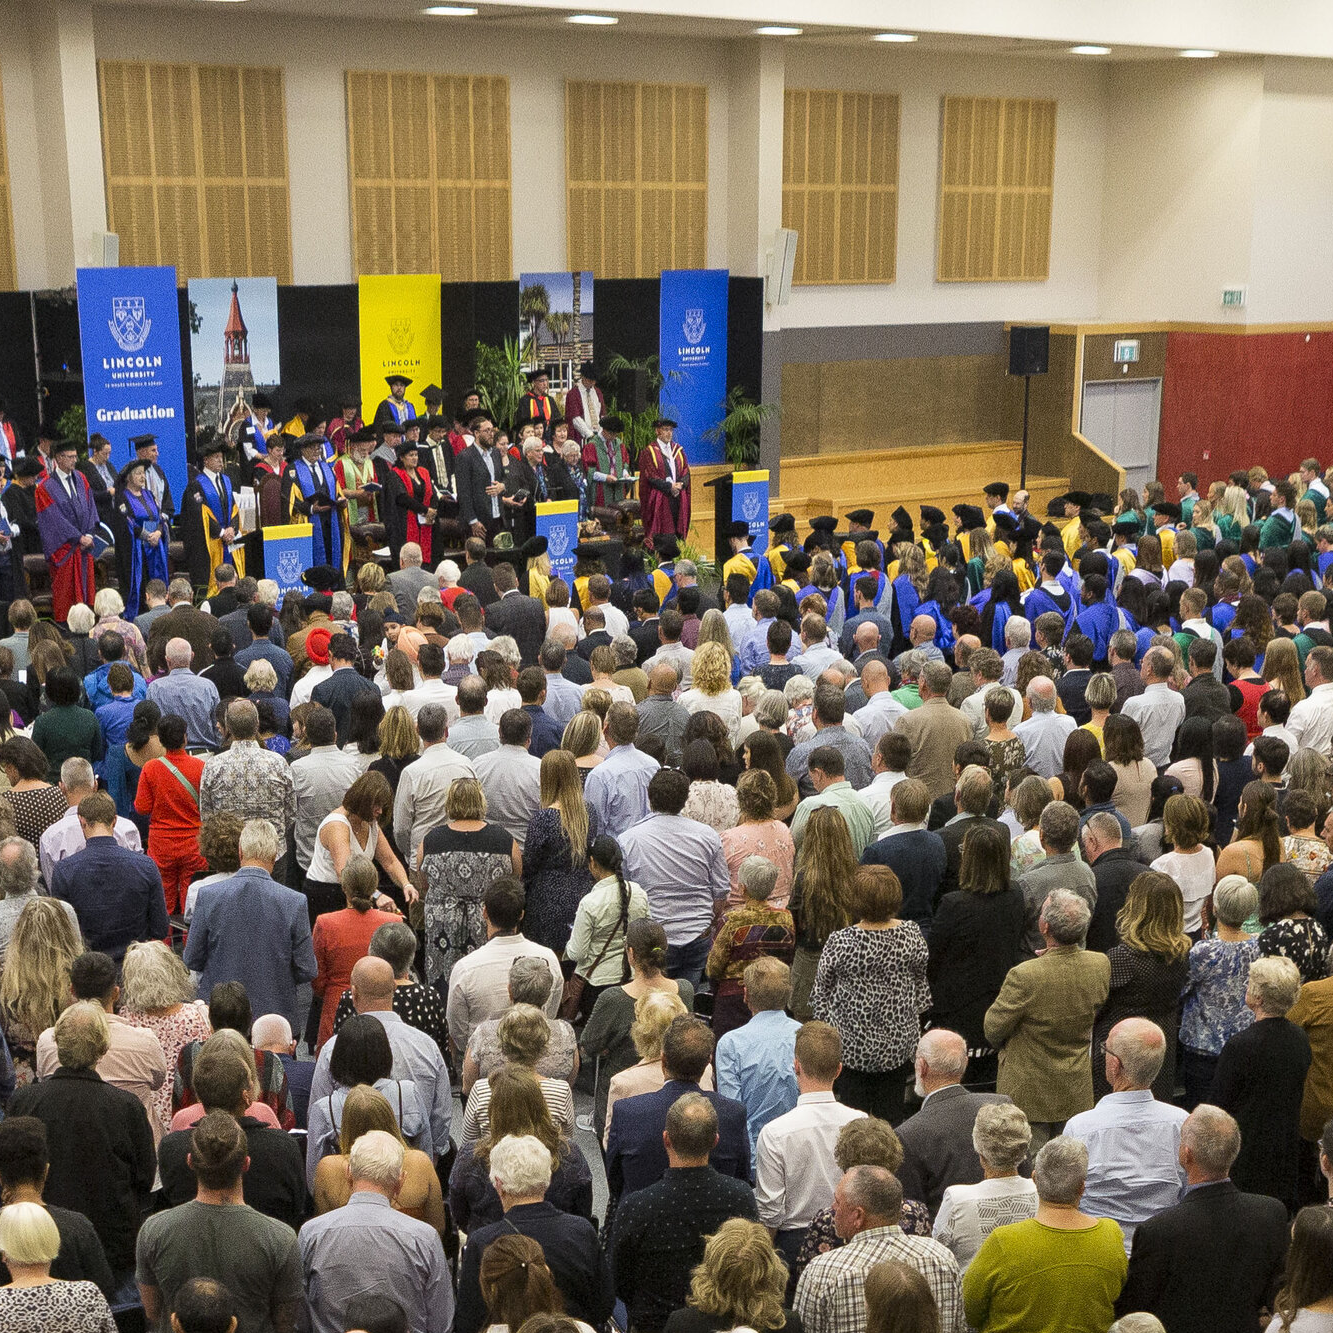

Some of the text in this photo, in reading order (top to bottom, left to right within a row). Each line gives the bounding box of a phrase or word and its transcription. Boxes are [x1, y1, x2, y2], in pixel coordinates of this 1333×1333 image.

[678, 346, 710, 355] LINCOLN
[102, 356, 162, 369] LINCOLN
[382, 359, 421, 367] LINCOLN
[111, 370, 155, 379] UNIVERSITY
[96, 404, 175, 422] Graduation
[277, 585, 309, 595] INCOLN
